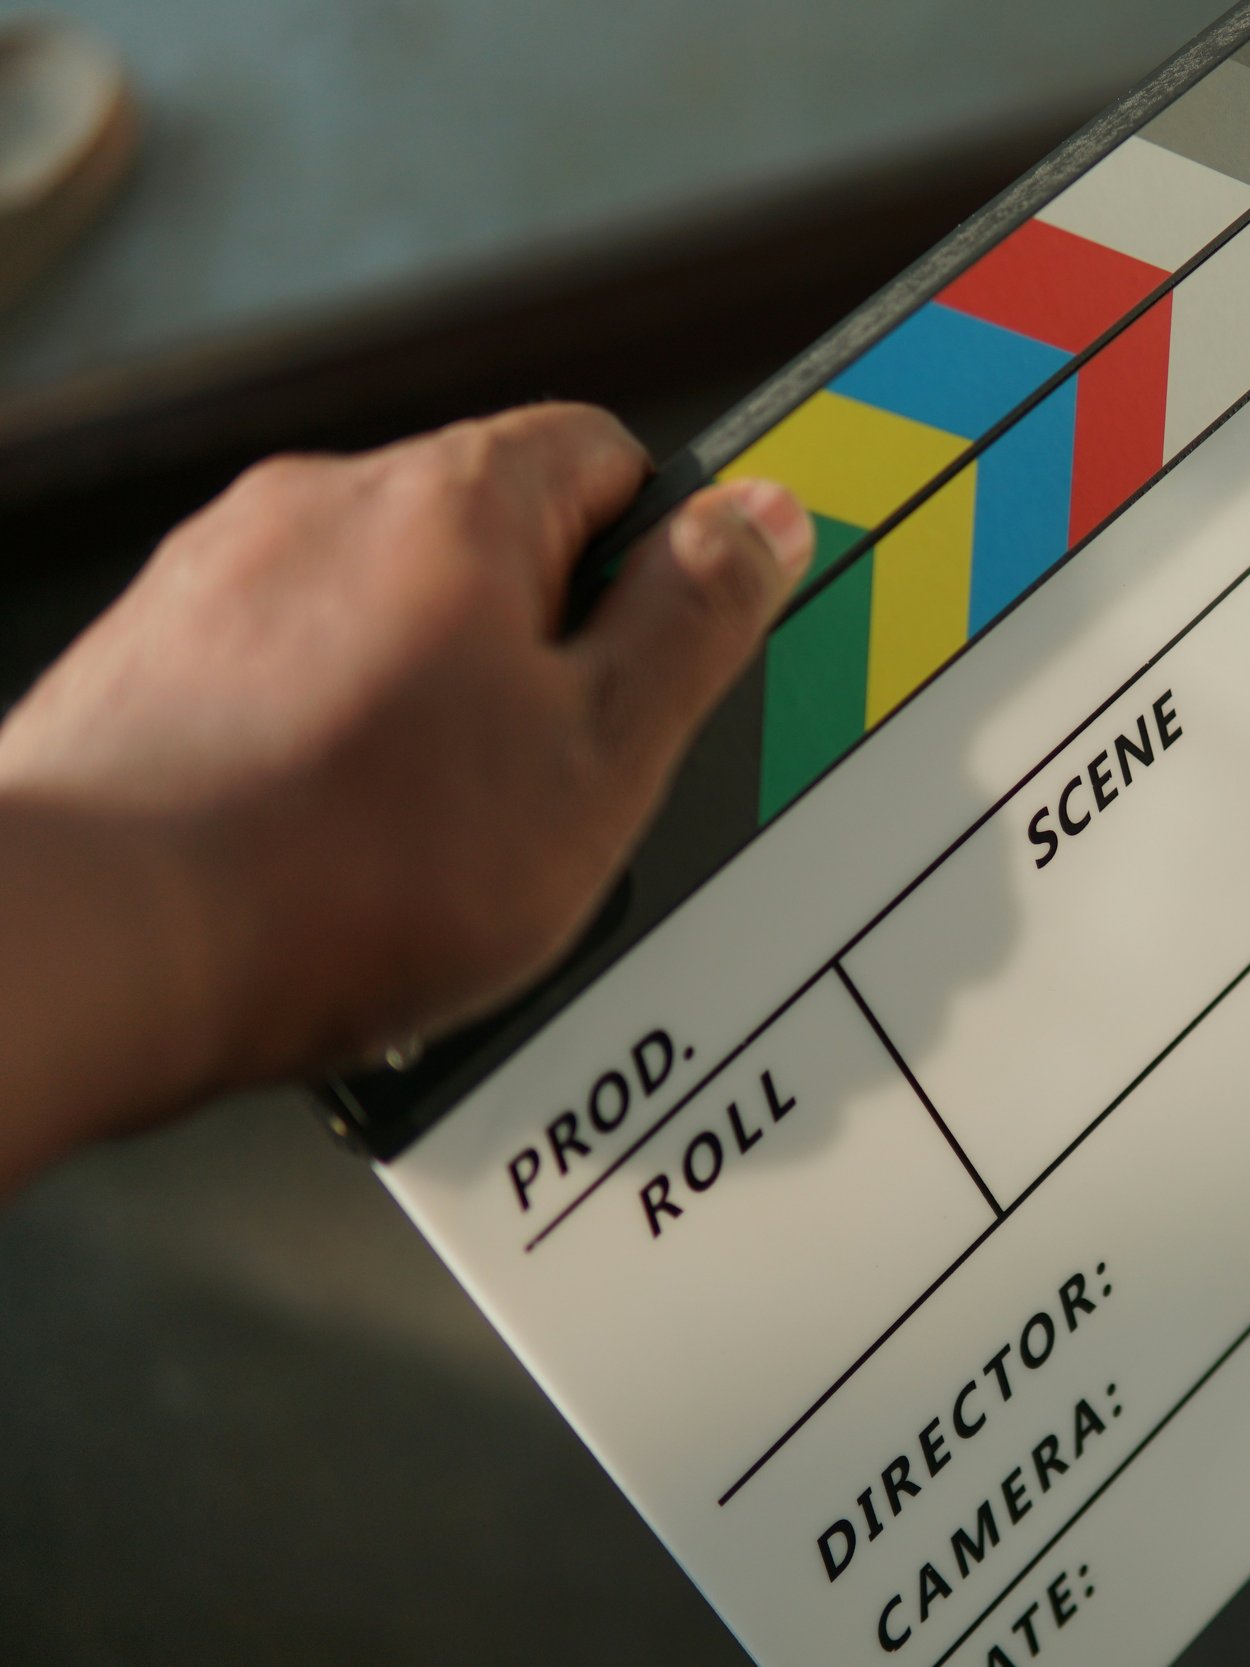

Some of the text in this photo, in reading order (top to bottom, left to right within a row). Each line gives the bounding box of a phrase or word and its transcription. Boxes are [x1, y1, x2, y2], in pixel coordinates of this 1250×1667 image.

[1027, 688, 1184, 870] SCENE
[506, 1029, 695, 1212] PROD.
[638, 1070, 797, 1239] ROLL
[816, 1261, 1113, 1583] DIRECTOR:
[876, 1382, 1123, 1654] CAMERA:
